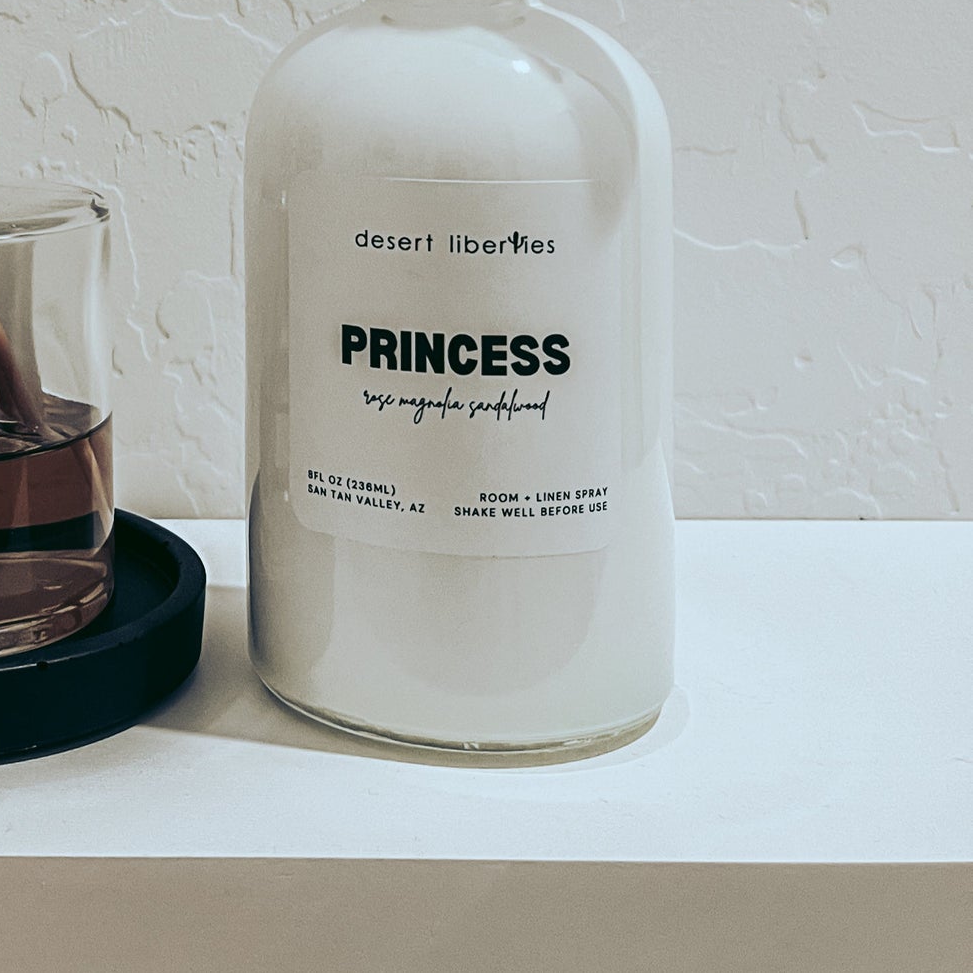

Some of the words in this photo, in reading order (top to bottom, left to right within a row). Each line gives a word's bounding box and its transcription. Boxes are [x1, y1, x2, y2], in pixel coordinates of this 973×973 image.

[354, 229, 434, 253] desert
[449, 231, 556, 255] liberties
[341, 323, 571, 377] PRINCESS
[362, 389, 396, 412] rose
[398, 386, 465, 425] magnolia
[468, 388, 551, 422] sandalwood
[307, 469, 325, 483] 8FL
[328, 474, 343, 487] OZ
[346, 477, 396, 497] (236ML)
[479, 492, 519, 504] ROOM
[535, 490, 571, 503] LINEN
[574, 486, 609, 500] SPRAY
[307, 483, 327, 498] SAN
[330, 489, 352, 503] TAN
[355, 494, 405, 514] VALLEY,
[409, 502, 426, 514] AZ
[453, 506, 497, 518] SHAKE
[501, 507, 536, 518] WELL
[540, 503, 585, 517] BEFORE
[588, 500, 608, 513] USE
